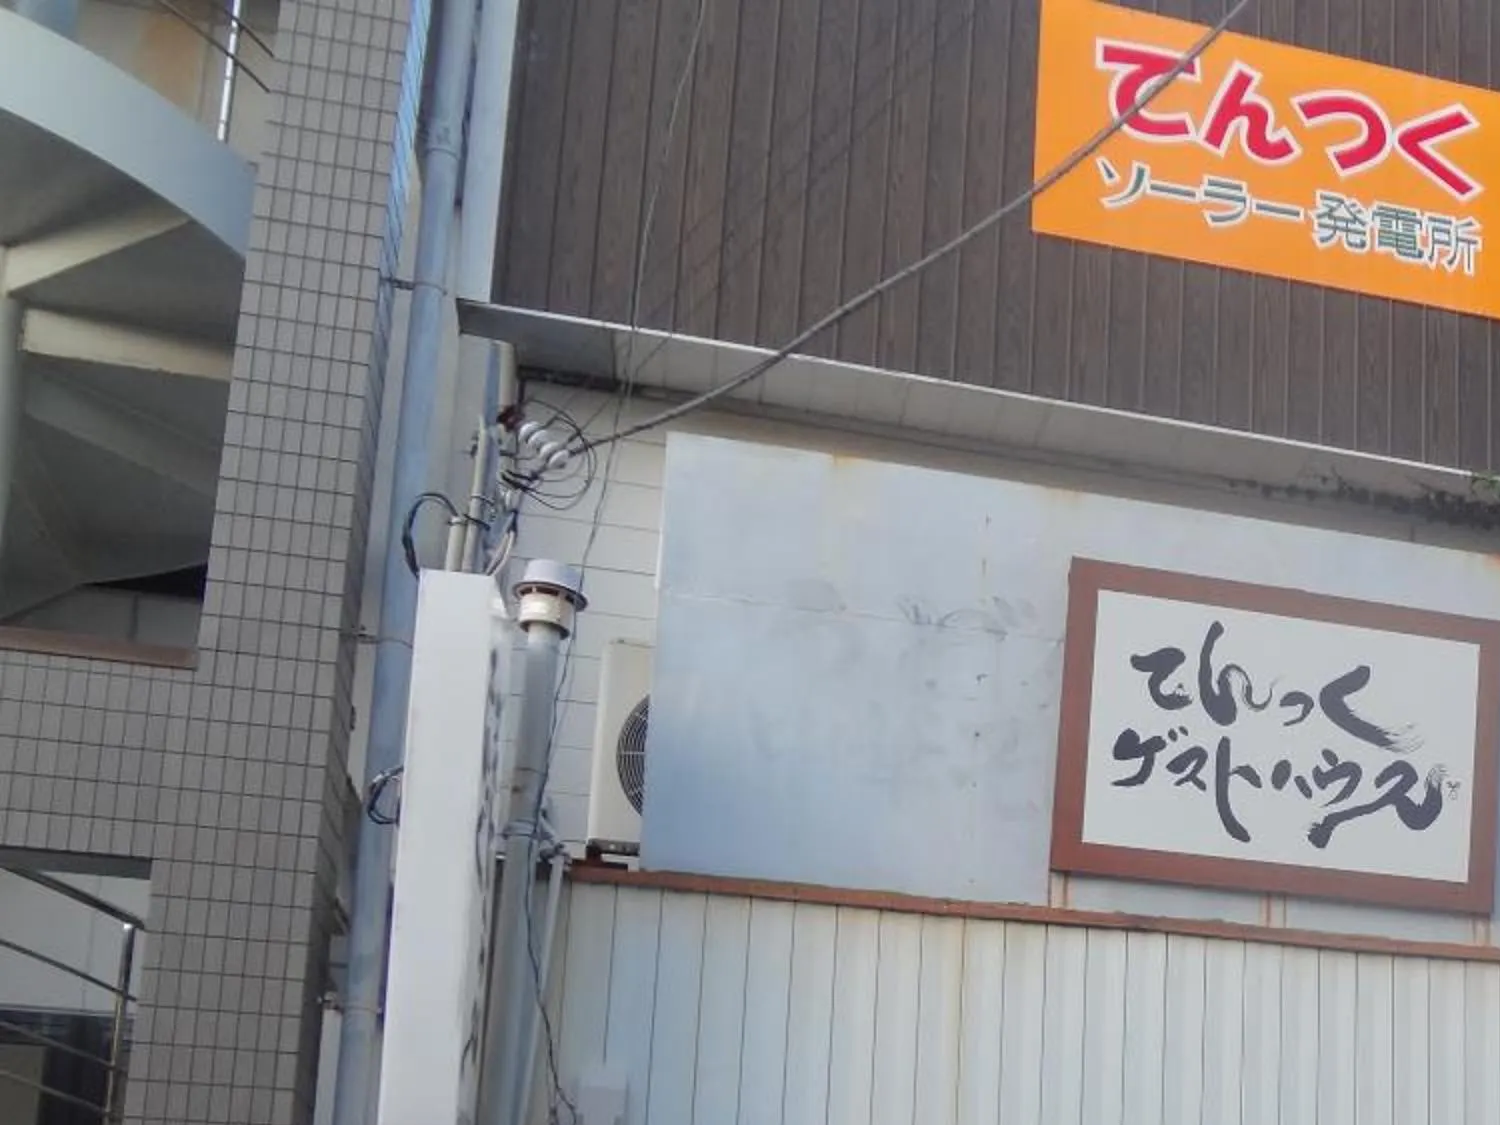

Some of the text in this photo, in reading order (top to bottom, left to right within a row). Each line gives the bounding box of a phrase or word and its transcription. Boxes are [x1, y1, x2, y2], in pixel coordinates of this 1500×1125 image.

[1095, 37, 1483, 201] てんつく
[1096, 157, 1483, 277] ソーラー発電所
[1111, 726, 1448, 849] ゲストハウス
